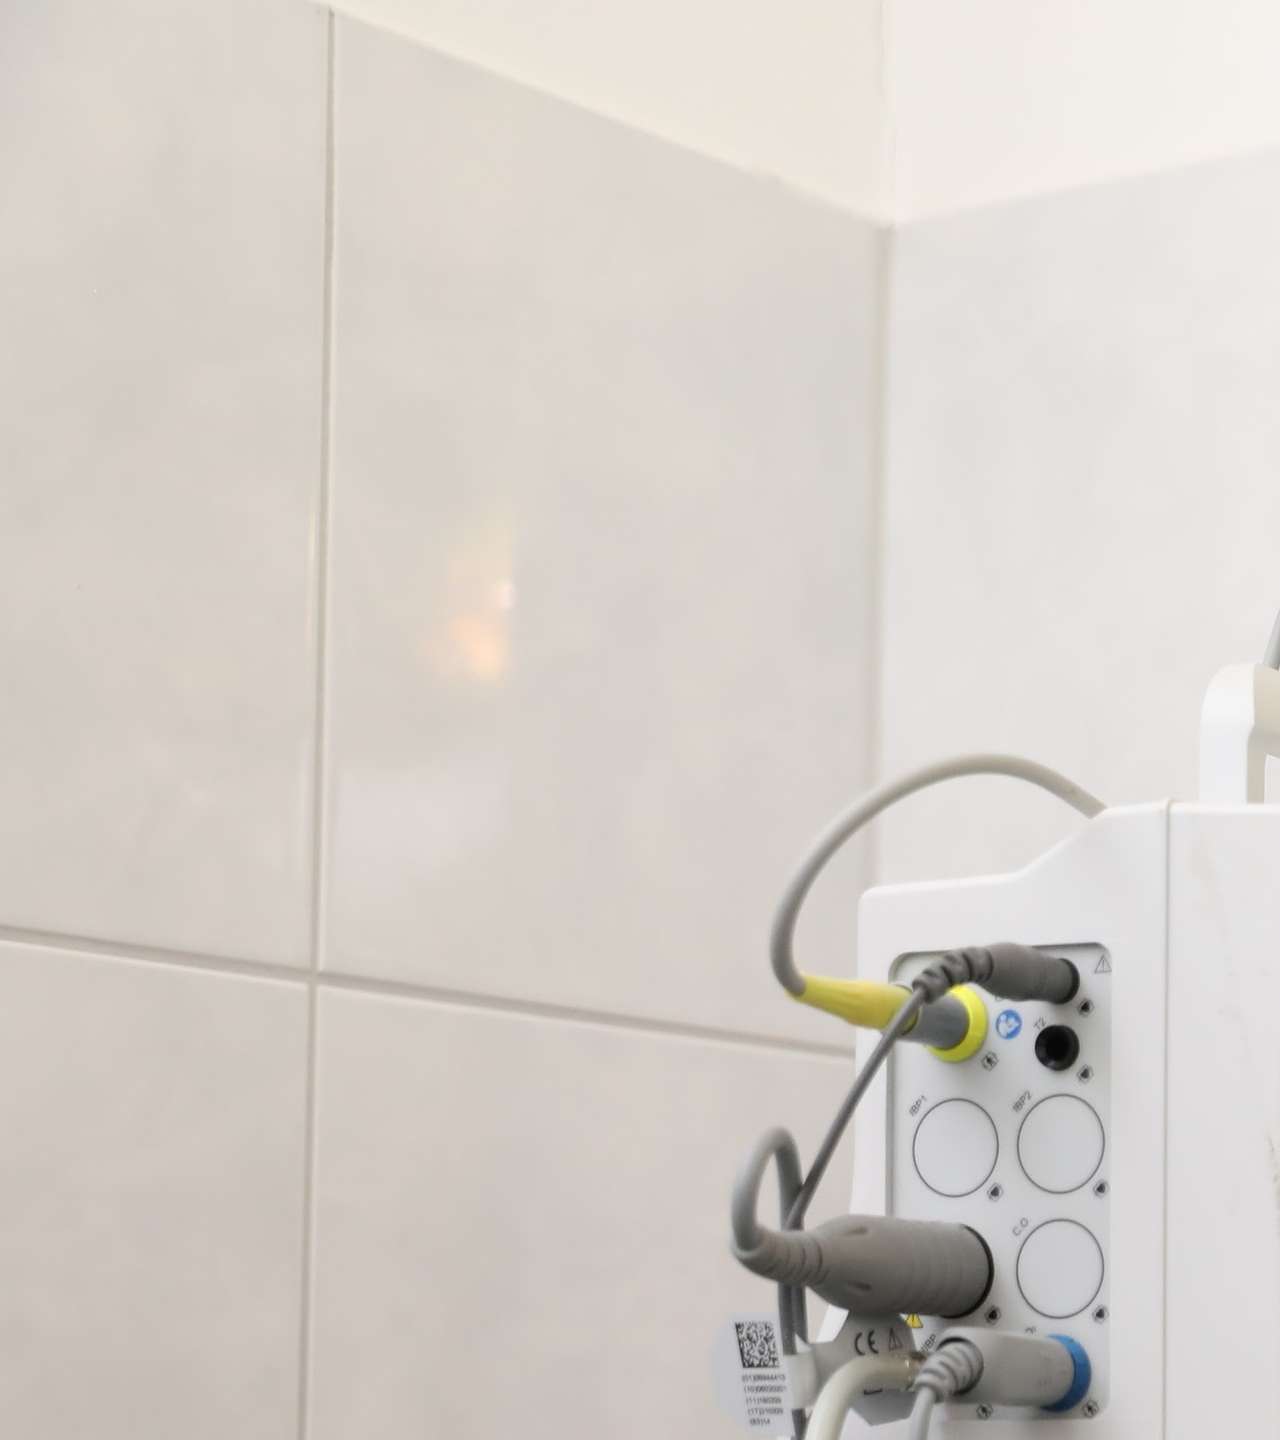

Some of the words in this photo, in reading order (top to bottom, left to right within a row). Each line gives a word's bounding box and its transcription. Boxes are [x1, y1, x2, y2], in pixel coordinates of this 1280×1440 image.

[1034, 1016, 1047, 1031] T2
[909, 1095, 928, 1116] IBP1
[1013, 1091, 1032, 1113] IBP2
